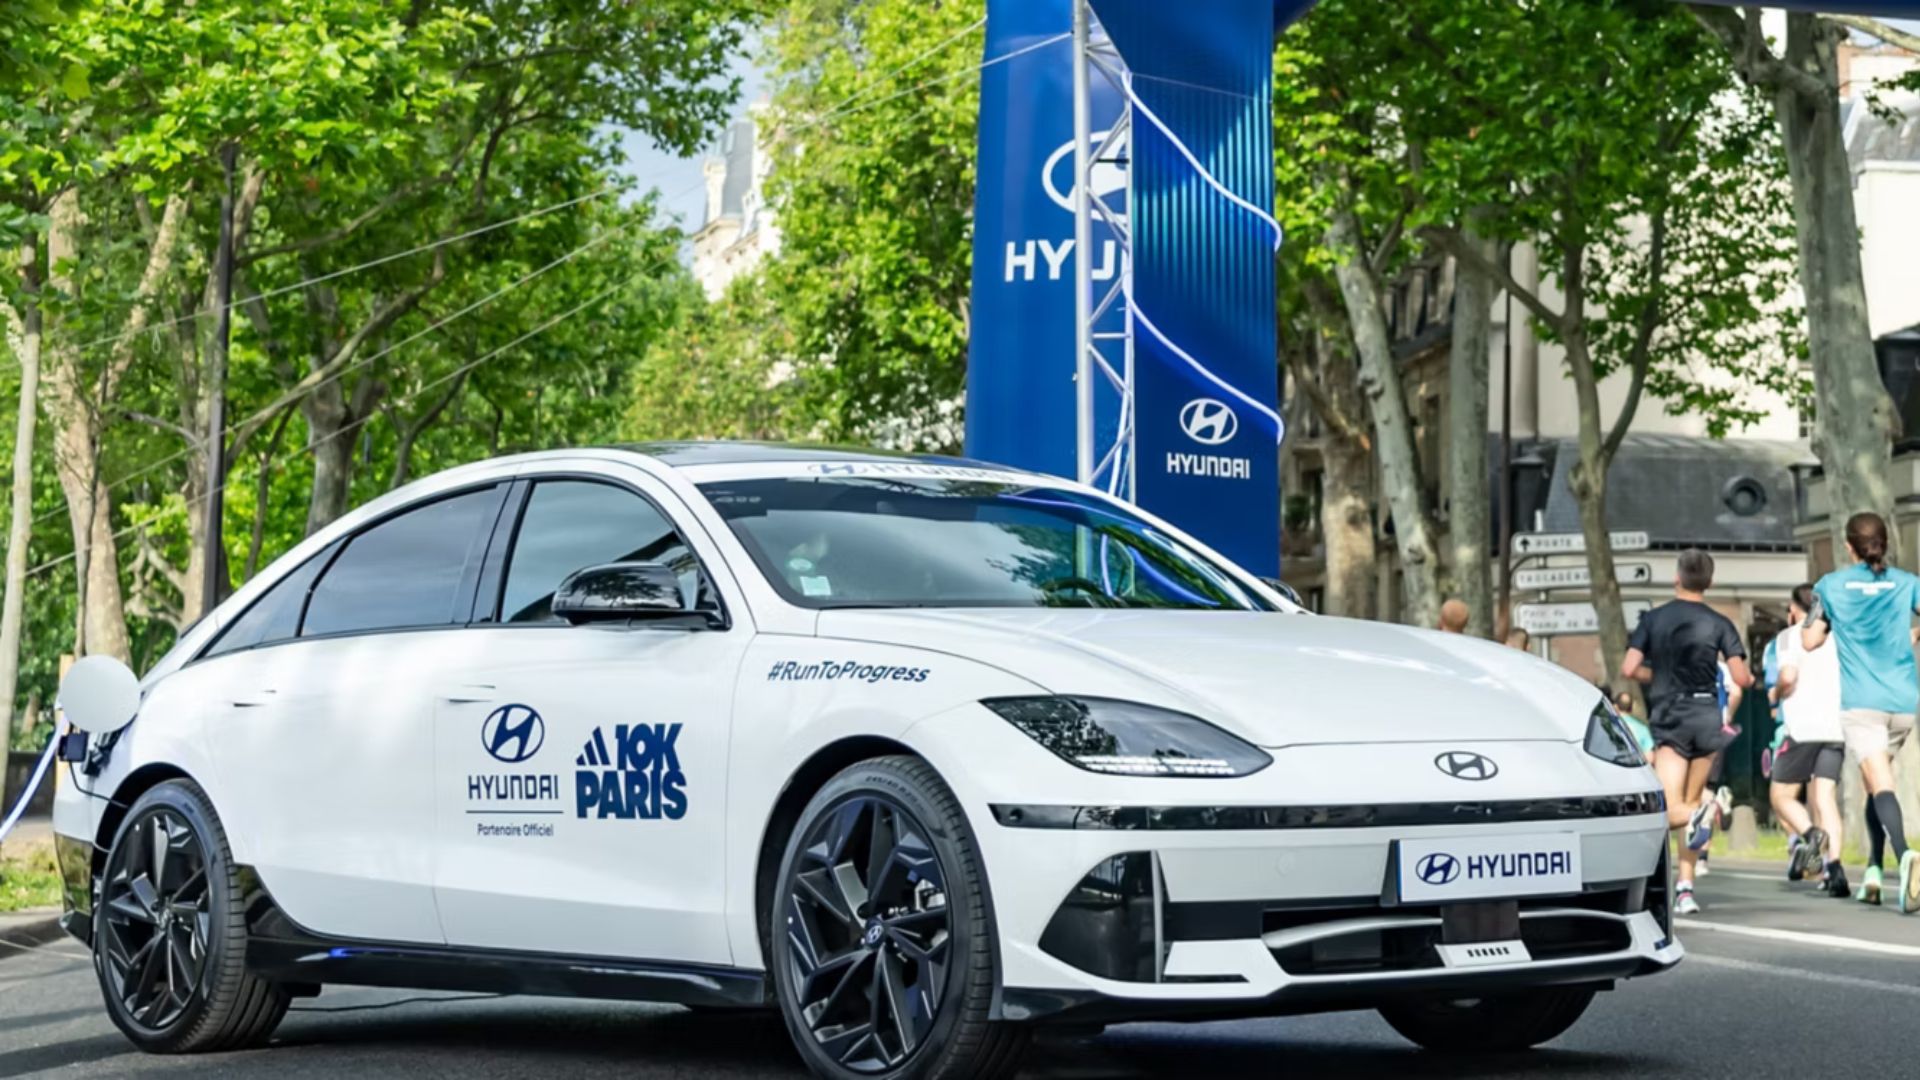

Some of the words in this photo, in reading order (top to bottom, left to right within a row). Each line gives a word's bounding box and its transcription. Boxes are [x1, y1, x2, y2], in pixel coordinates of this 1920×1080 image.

[1166, 451, 1251, 480] HYUNDAI
[767, 660, 931, 683] #RunToProgress
[615, 722, 683, 771] 10K
[468, 774, 559, 800] HYUNDAI
[575, 769, 688, 820] PARIS
[477, 822, 521, 836] Partenaire
[522, 822, 554, 836] Officiel
[1467, 850, 1571, 879] HYUNDAI
